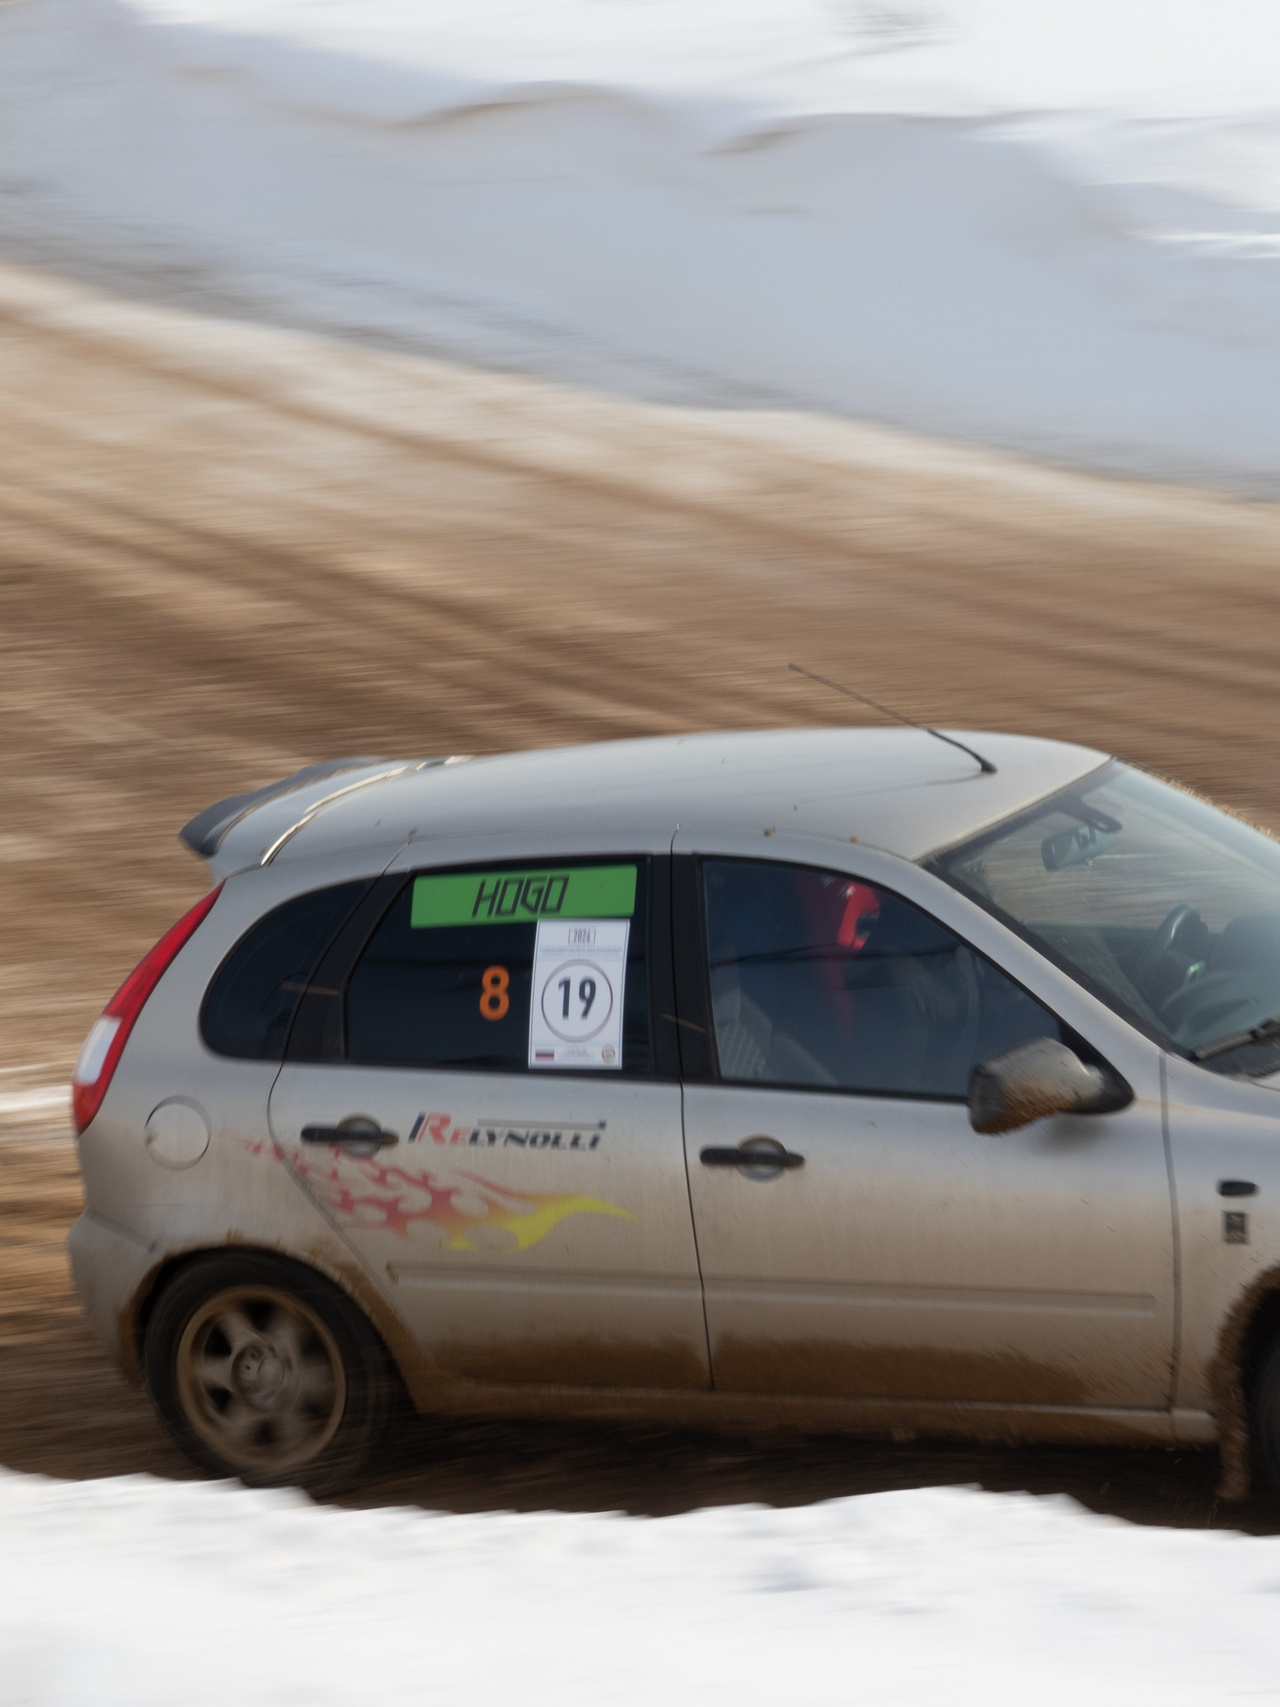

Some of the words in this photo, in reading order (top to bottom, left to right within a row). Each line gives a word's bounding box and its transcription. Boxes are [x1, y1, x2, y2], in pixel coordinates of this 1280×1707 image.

[473, 875, 569, 918] HOGO
[480, 965, 509, 1021] 8
[558, 975, 597, 1021] 19
